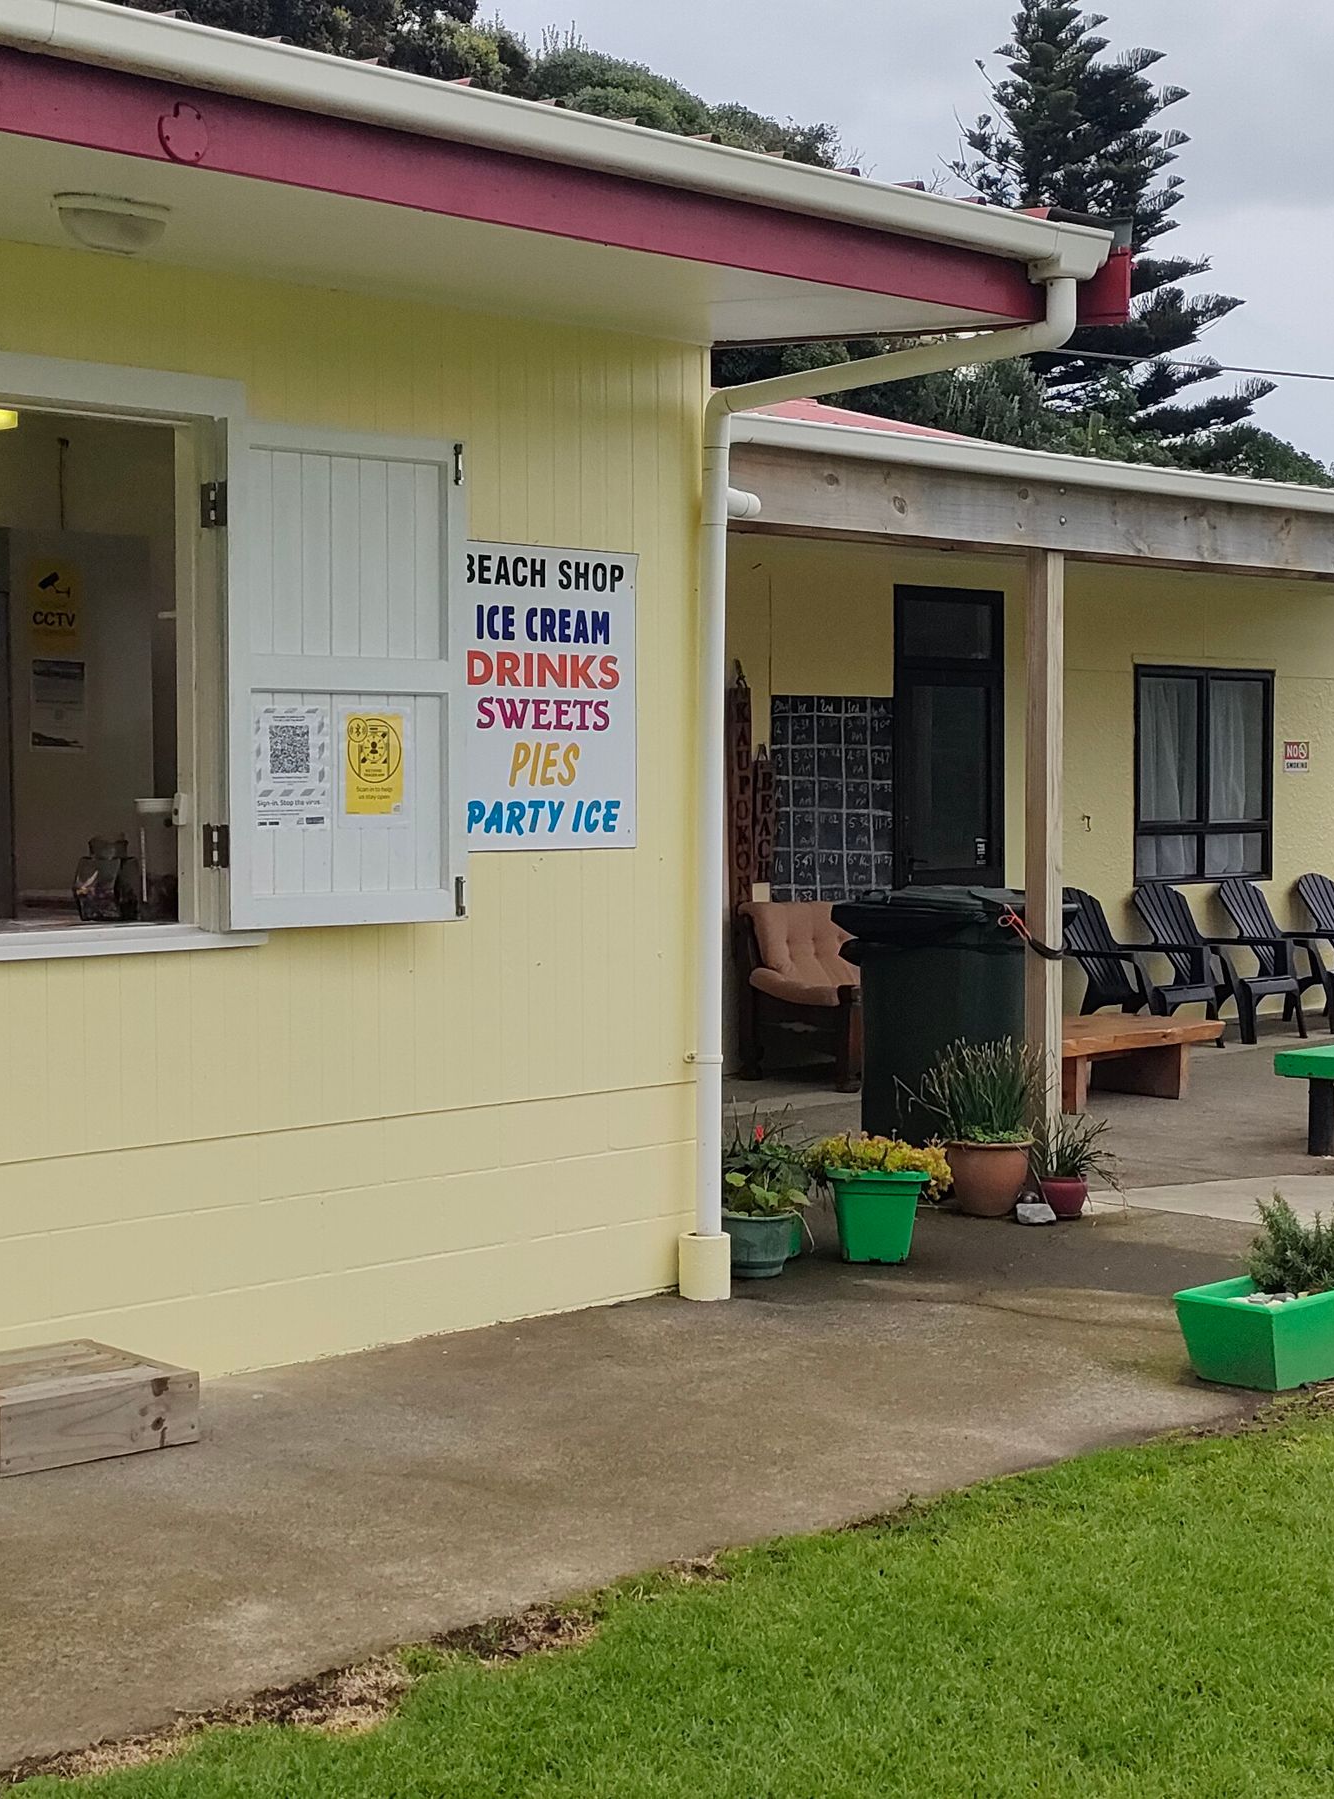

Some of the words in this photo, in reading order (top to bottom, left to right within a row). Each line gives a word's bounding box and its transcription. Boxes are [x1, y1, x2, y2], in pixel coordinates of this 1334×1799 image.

[467, 553, 546, 588] BEACH
[558, 559, 624, 593] SHOP
[33, 611, 75, 627] CCTV
[476, 604, 515, 641] ICE
[525, 607, 610, 645] CREAM
[467, 650, 620, 690] DRINKS
[476, 697, 610, 731] SWEETS
[509, 742, 580, 788] PIES
[1286, 744, 1299, 758] NO
[467, 800, 565, 835] PARTY
[572, 800, 621, 833] ICE
[735, 702, 751, 912] KAUPOKON
[757, 771, 772, 881] BEACH
